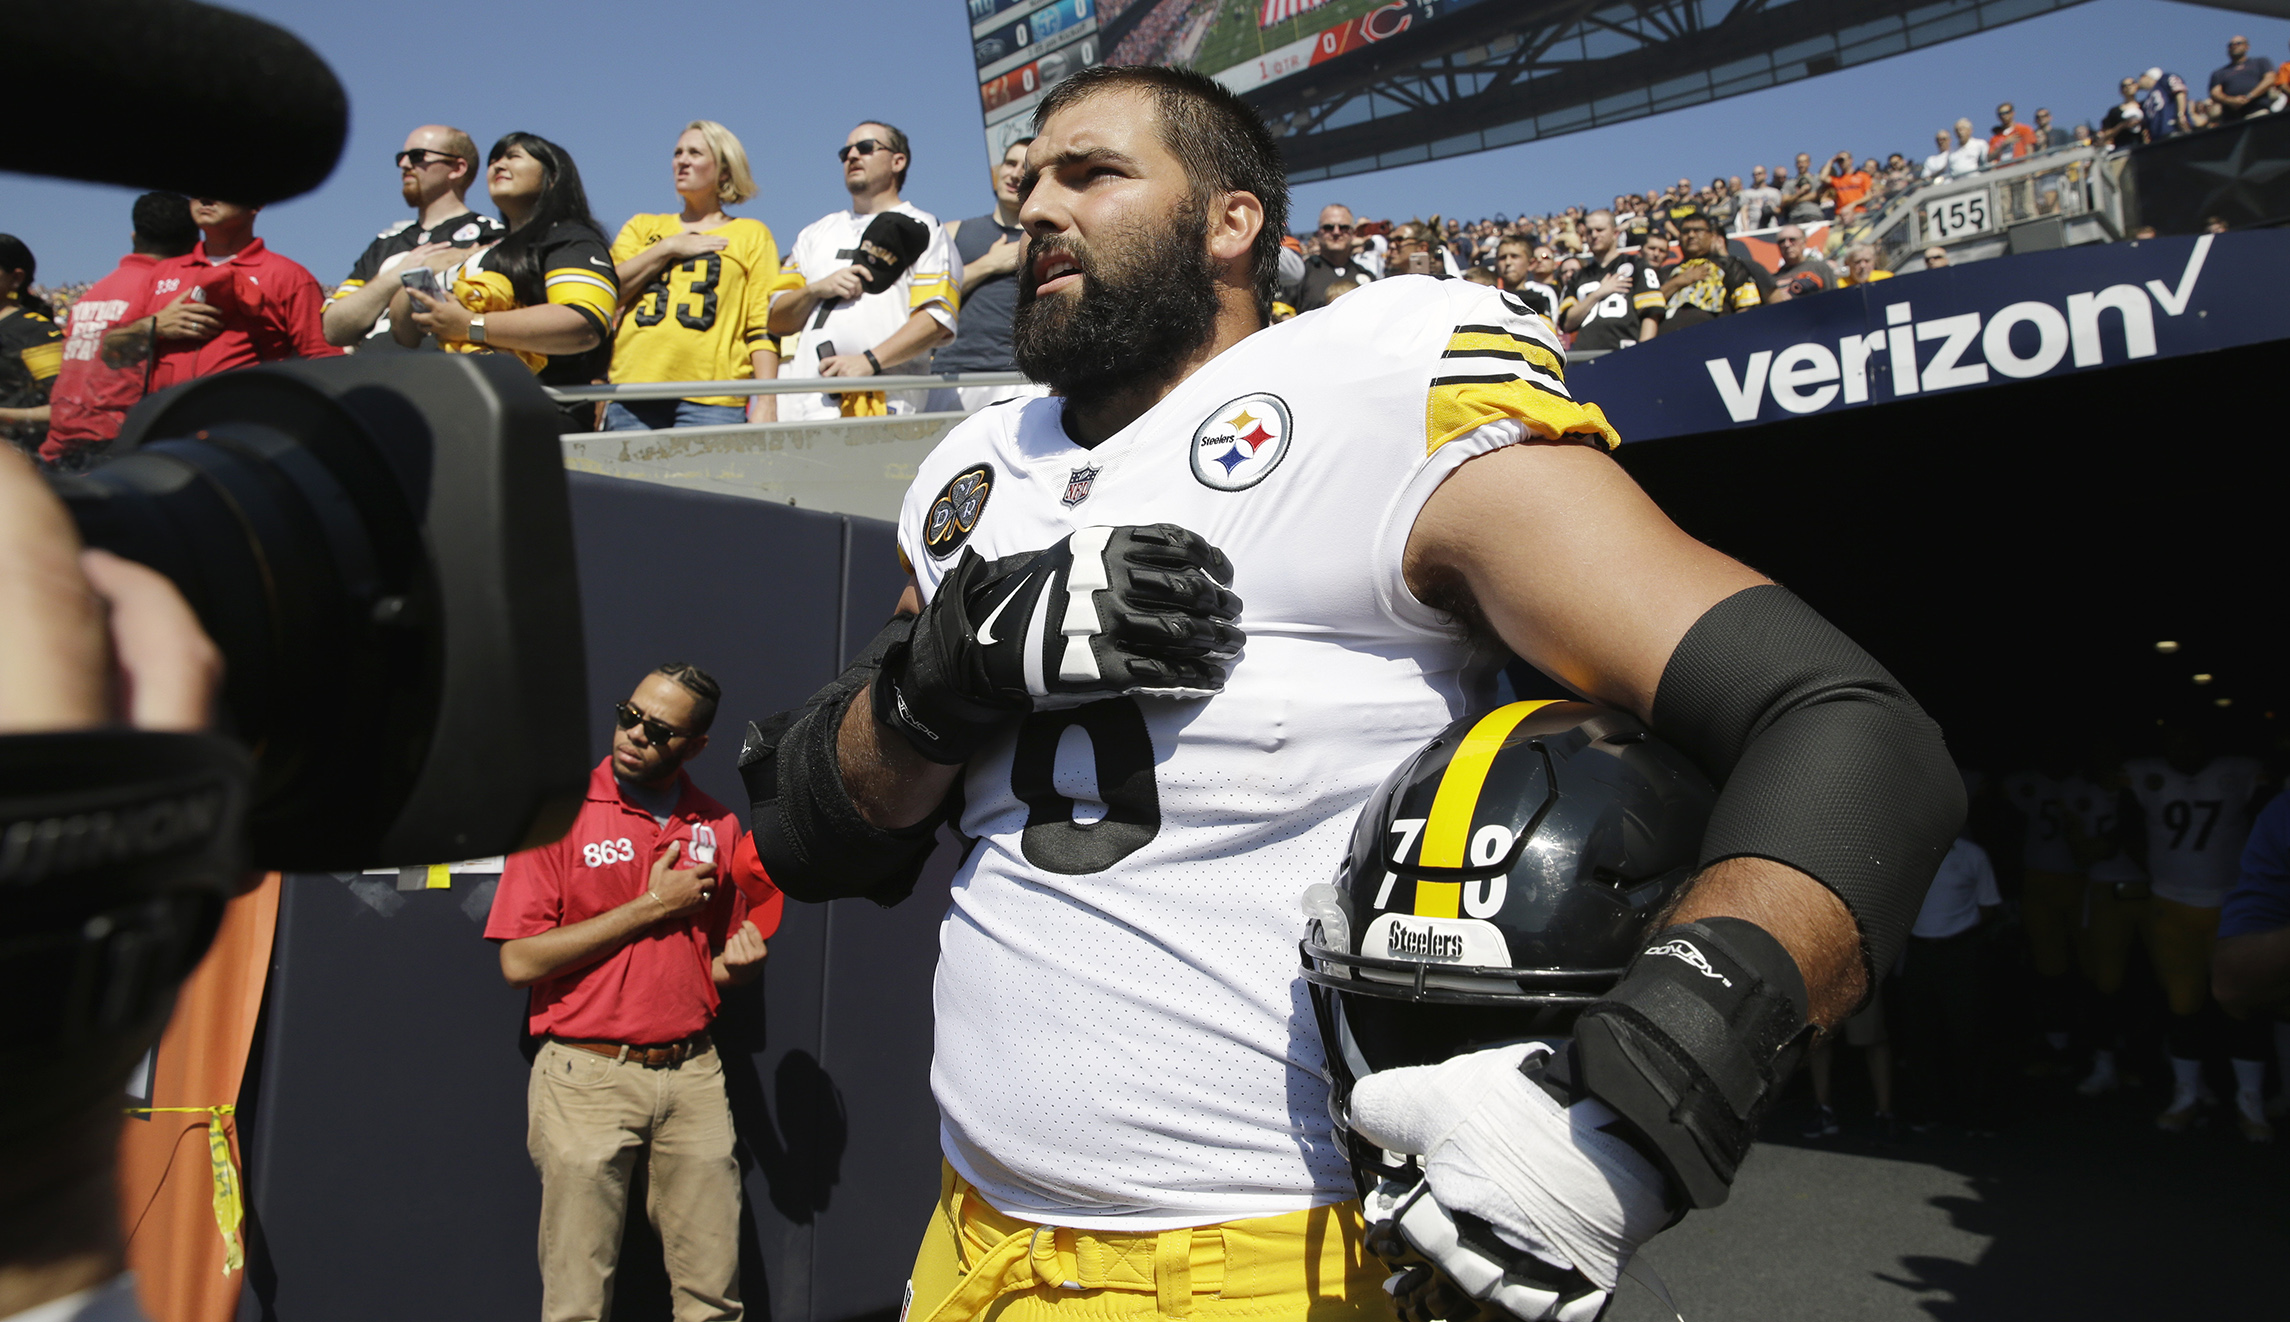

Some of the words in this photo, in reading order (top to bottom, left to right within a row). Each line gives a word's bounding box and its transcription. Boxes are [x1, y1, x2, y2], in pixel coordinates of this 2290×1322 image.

[1015, 23, 1028, 47] 0
[1322, 32, 1337, 54] 0
[1081, 41, 1094, 66] 0
[1022, 68, 1035, 92] 0
[1259, 61, 1269, 80] 1
[1932, 198, 1984, 237] 155
[1706, 285, 2157, 423] verizon
[1200, 434, 1235, 447] Steelers
[2163, 800, 2223, 852] 97
[583, 837, 635, 868] 863
[1388, 920, 1464, 957] Steelers
